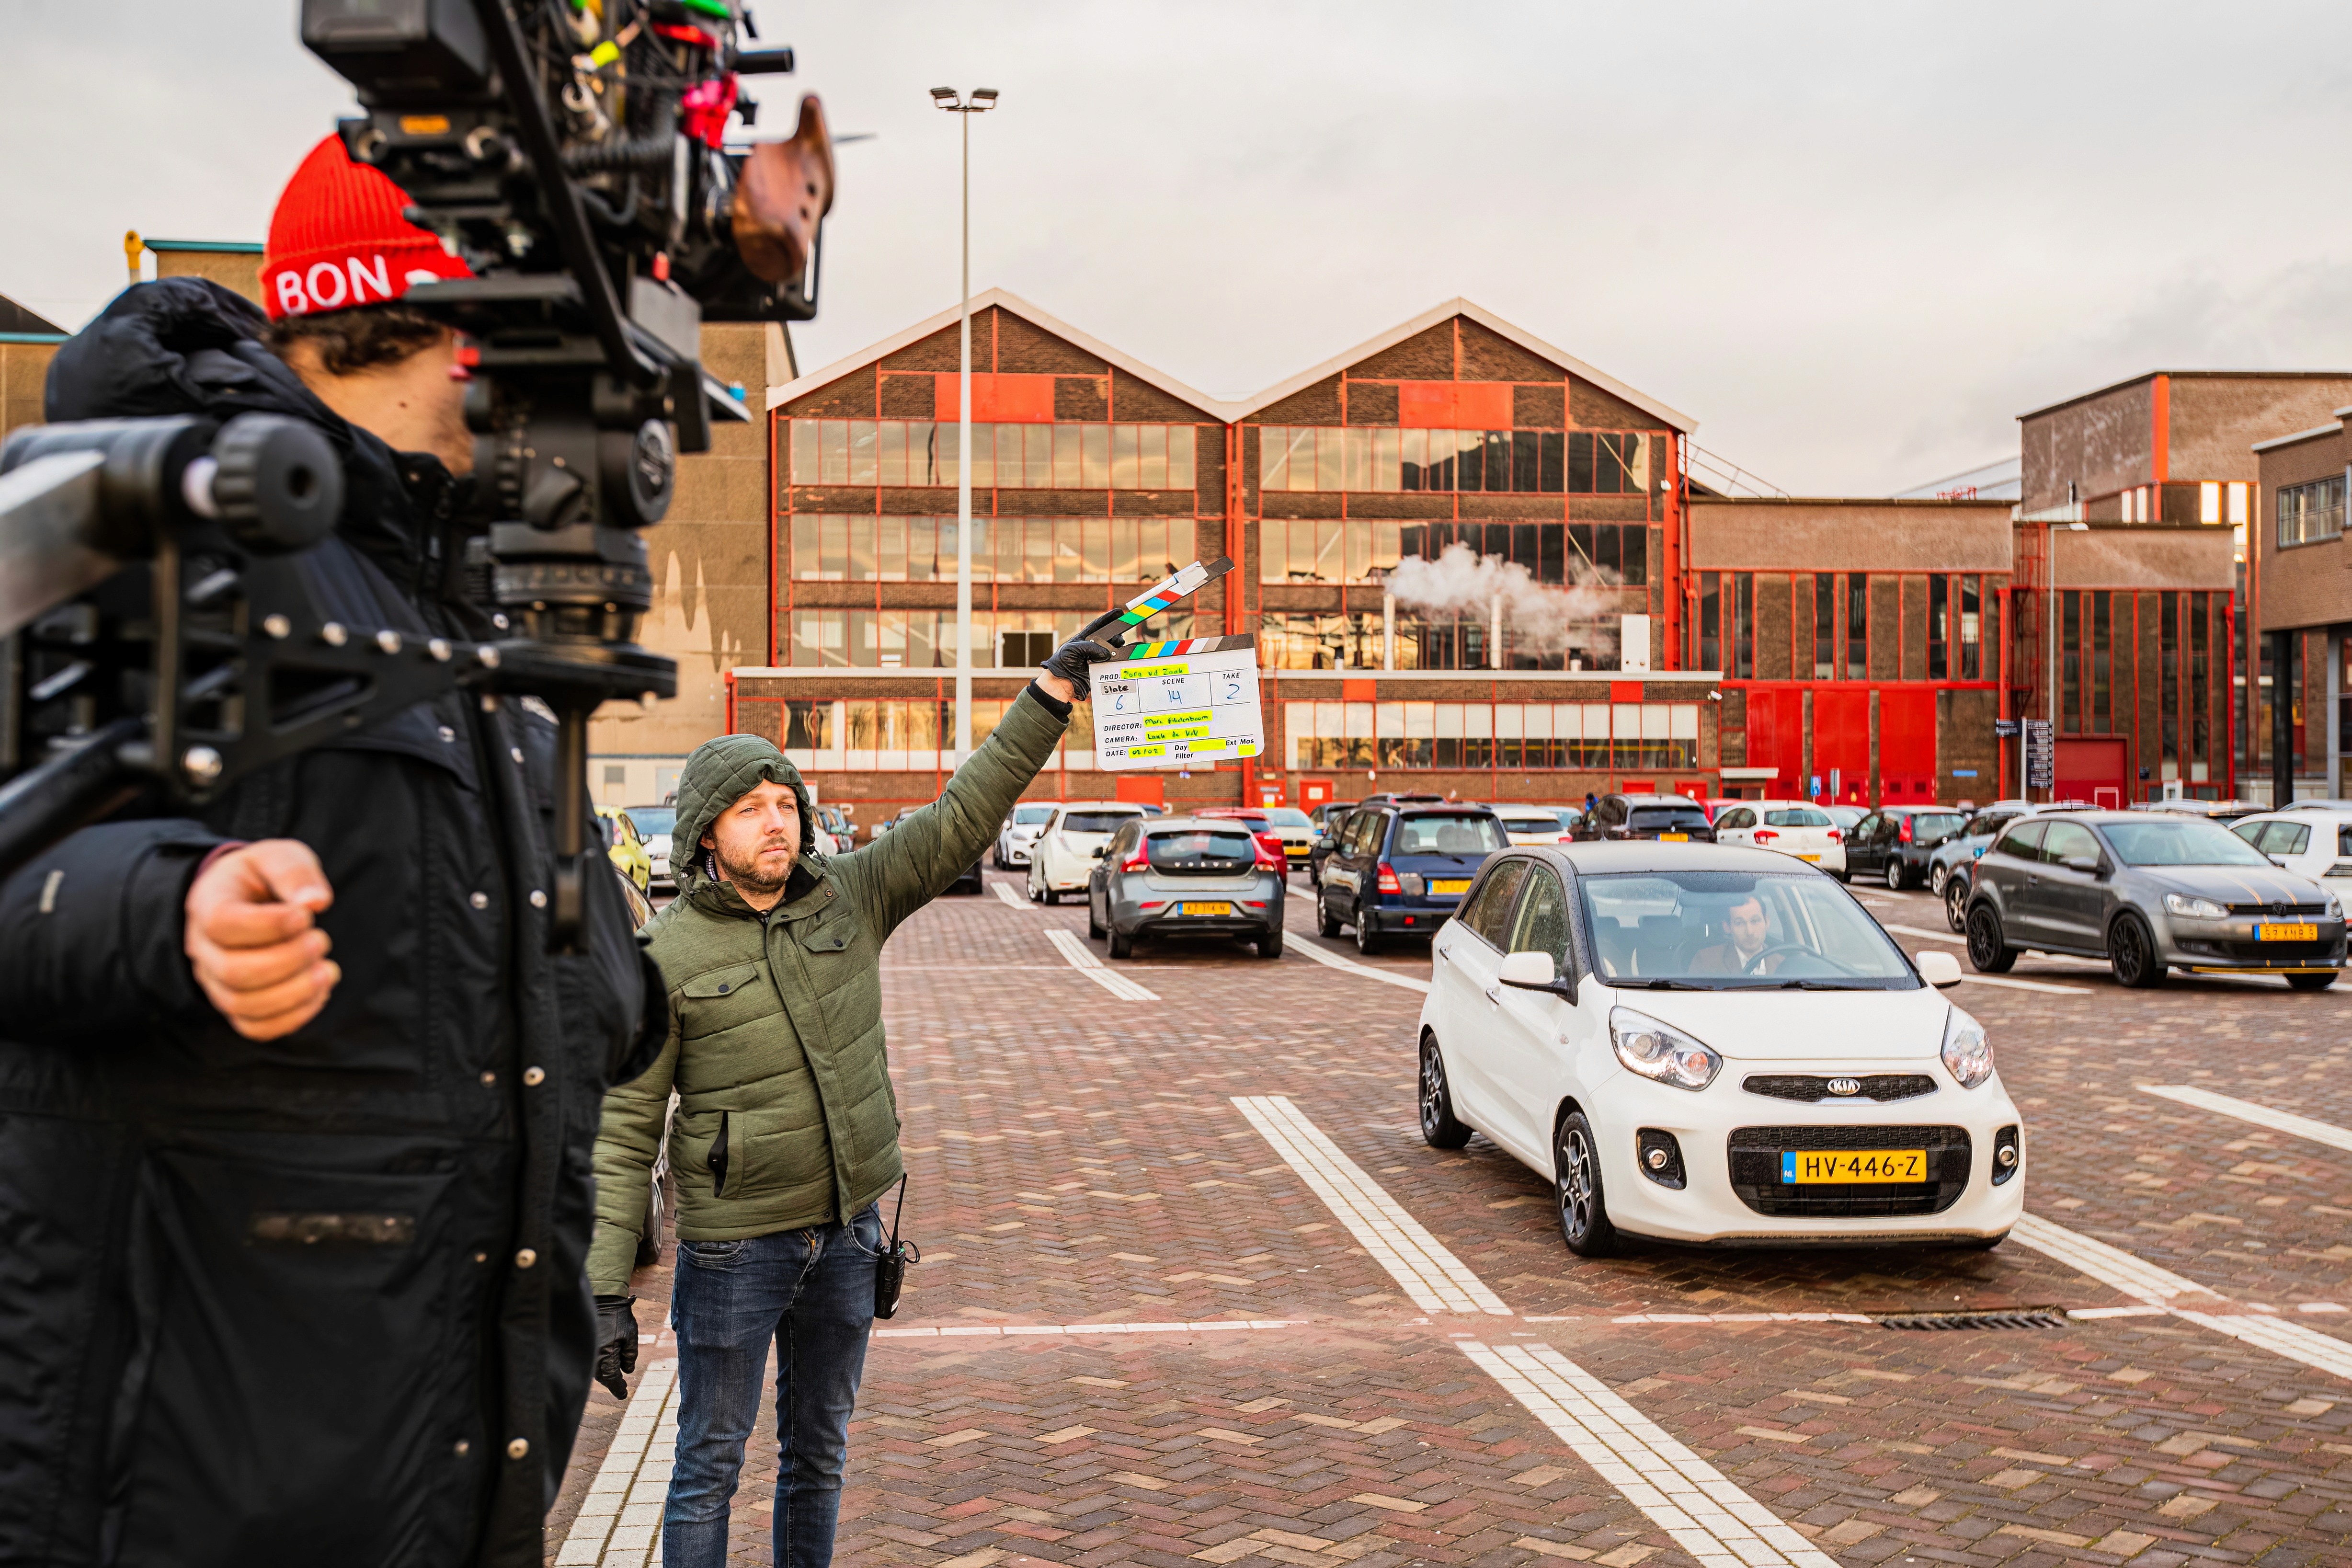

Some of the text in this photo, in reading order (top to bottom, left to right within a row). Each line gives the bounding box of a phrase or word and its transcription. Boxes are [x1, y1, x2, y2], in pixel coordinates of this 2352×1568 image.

[276, 254, 393, 316] BON
[1103, 685, 1129, 694] Slate
[1168, 689, 1182, 704] 14
[1227, 684, 1240, 699] 2
[1116, 695, 1123, 710] 6
[1104, 723, 1142, 732] DIRECTOR:
[1105, 735, 1137, 744] CAMERA:
[1833, 1080, 1857, 1092] KIA
[1806, 1156, 1918, 1177] HV-446-Z
